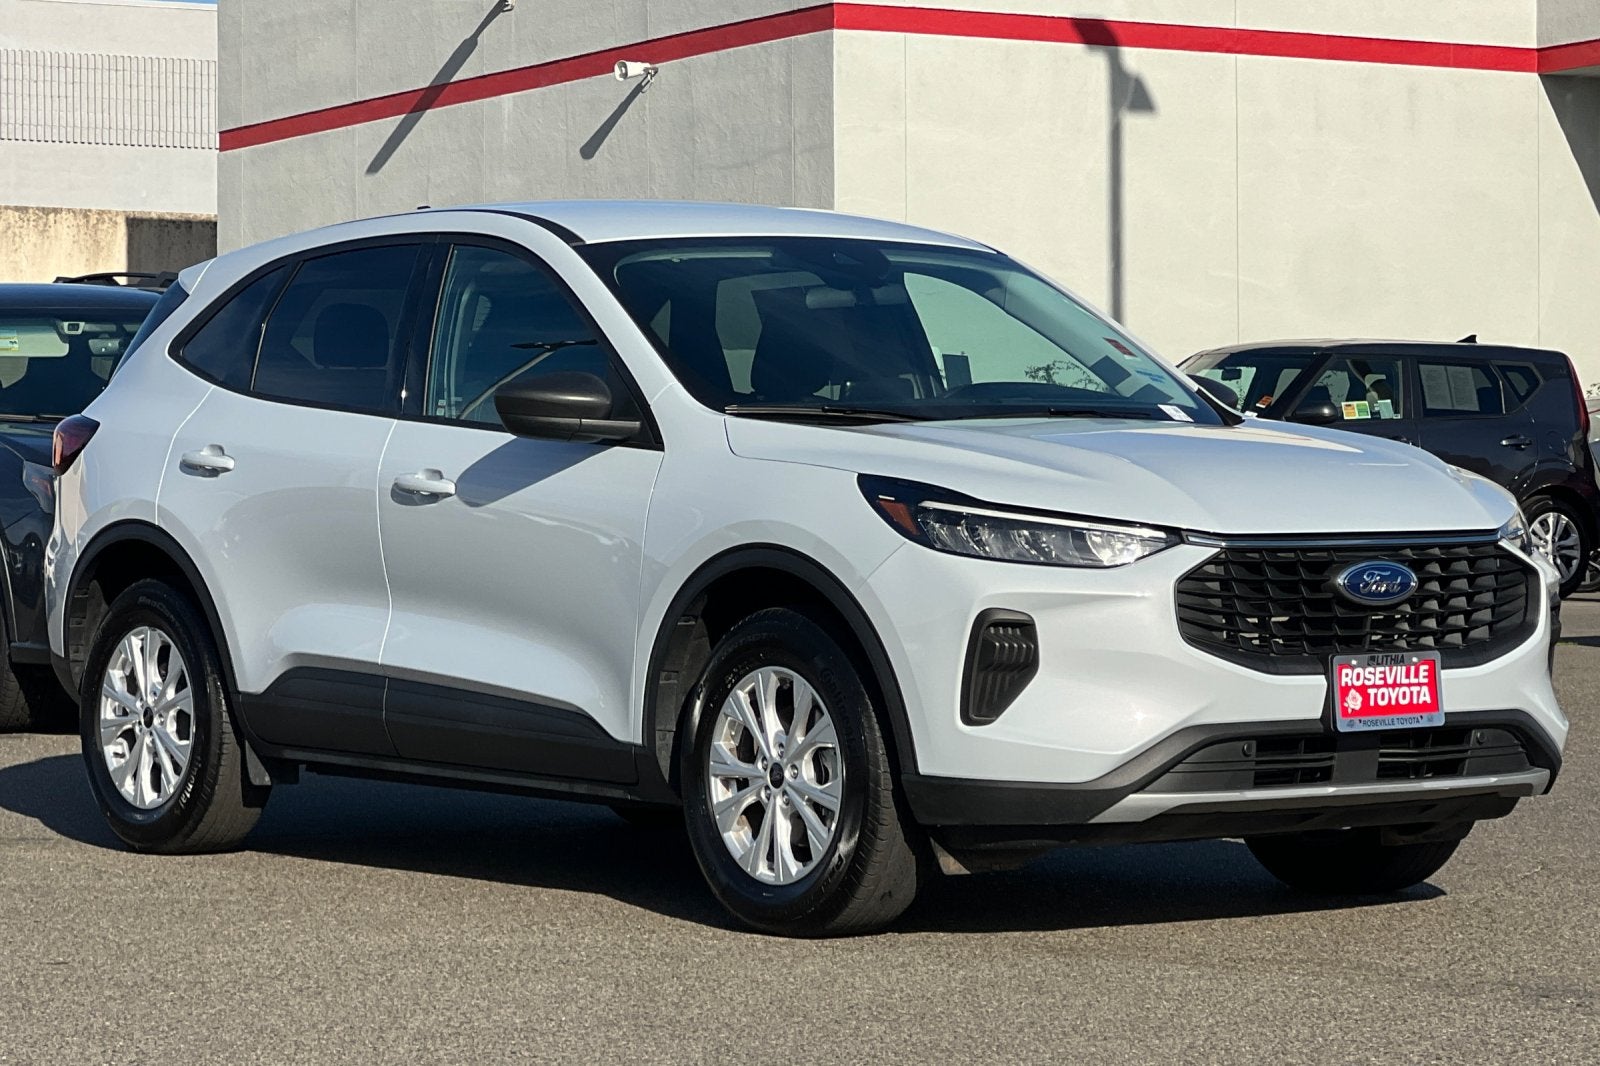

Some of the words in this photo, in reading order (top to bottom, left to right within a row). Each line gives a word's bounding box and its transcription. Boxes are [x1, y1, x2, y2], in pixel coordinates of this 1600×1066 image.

[1360, 570, 1401, 593] Ford
[1376, 654, 1405, 665] LITHIA
[1341, 666, 1429, 687] ROSEVILLE
[1367, 686, 1432, 707] TOYOTA
[1362, 719, 1396, 728] ROSEVILLE
[1397, 718, 1420, 726] TOYOTA
